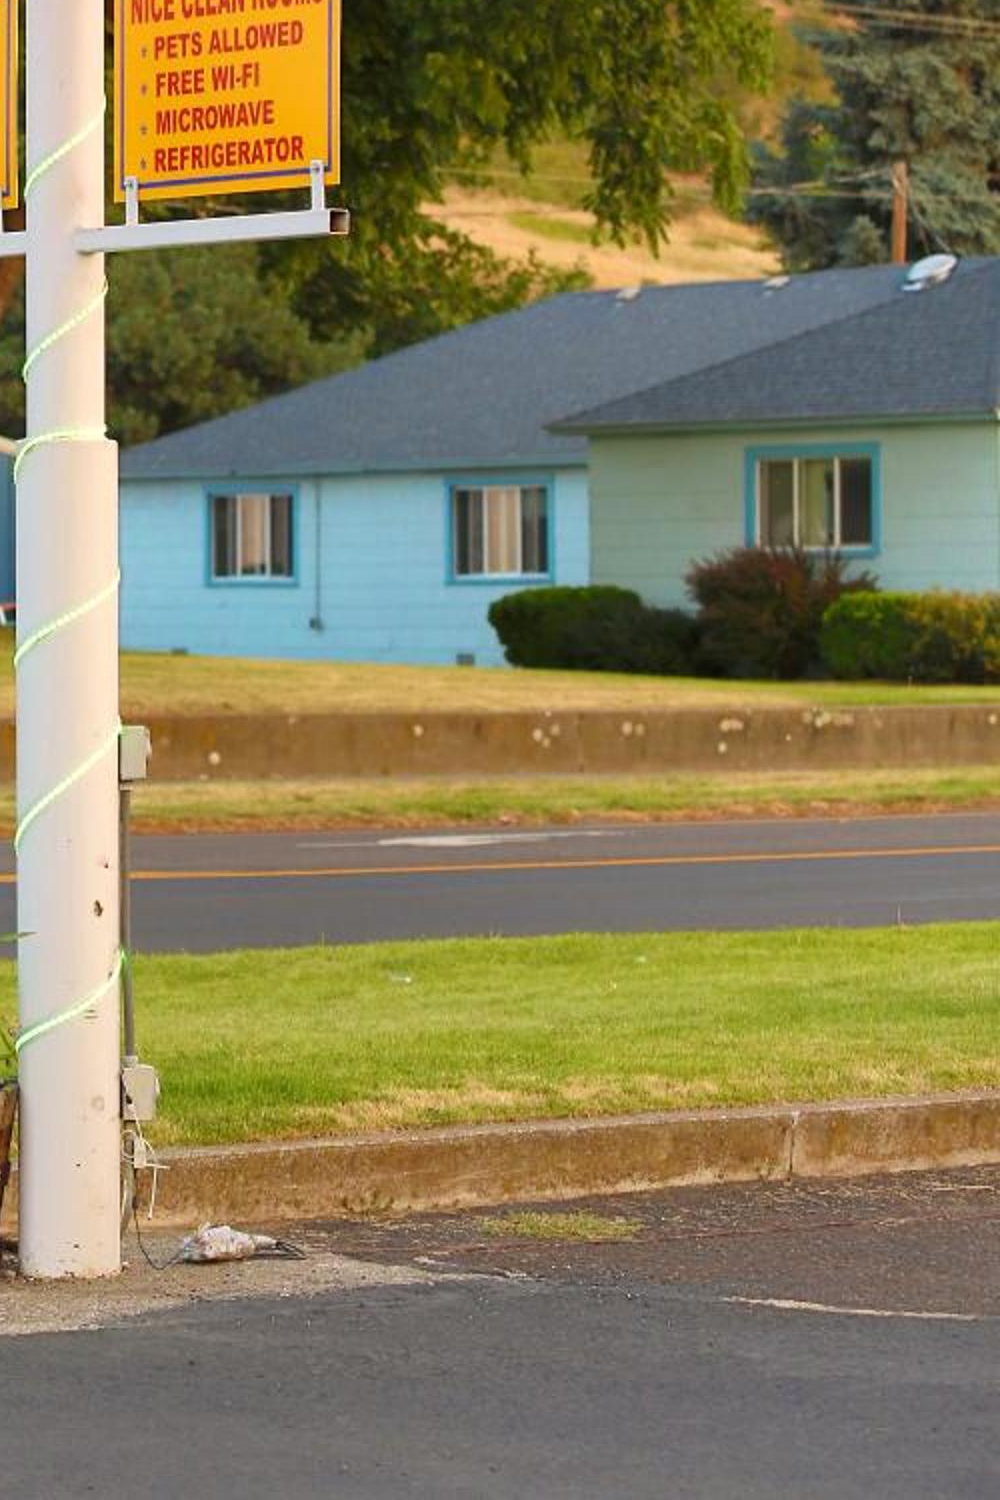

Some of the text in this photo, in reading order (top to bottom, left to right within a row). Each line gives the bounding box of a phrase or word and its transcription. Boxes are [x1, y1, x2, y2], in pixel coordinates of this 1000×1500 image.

[154, 20, 303, 60] PETS ALLOWED
[155, 62, 260, 98] FREE WI-FI
[155, 100, 274, 135] MICROWAVE
[154, 135, 304, 172] REFRIGERATOR
